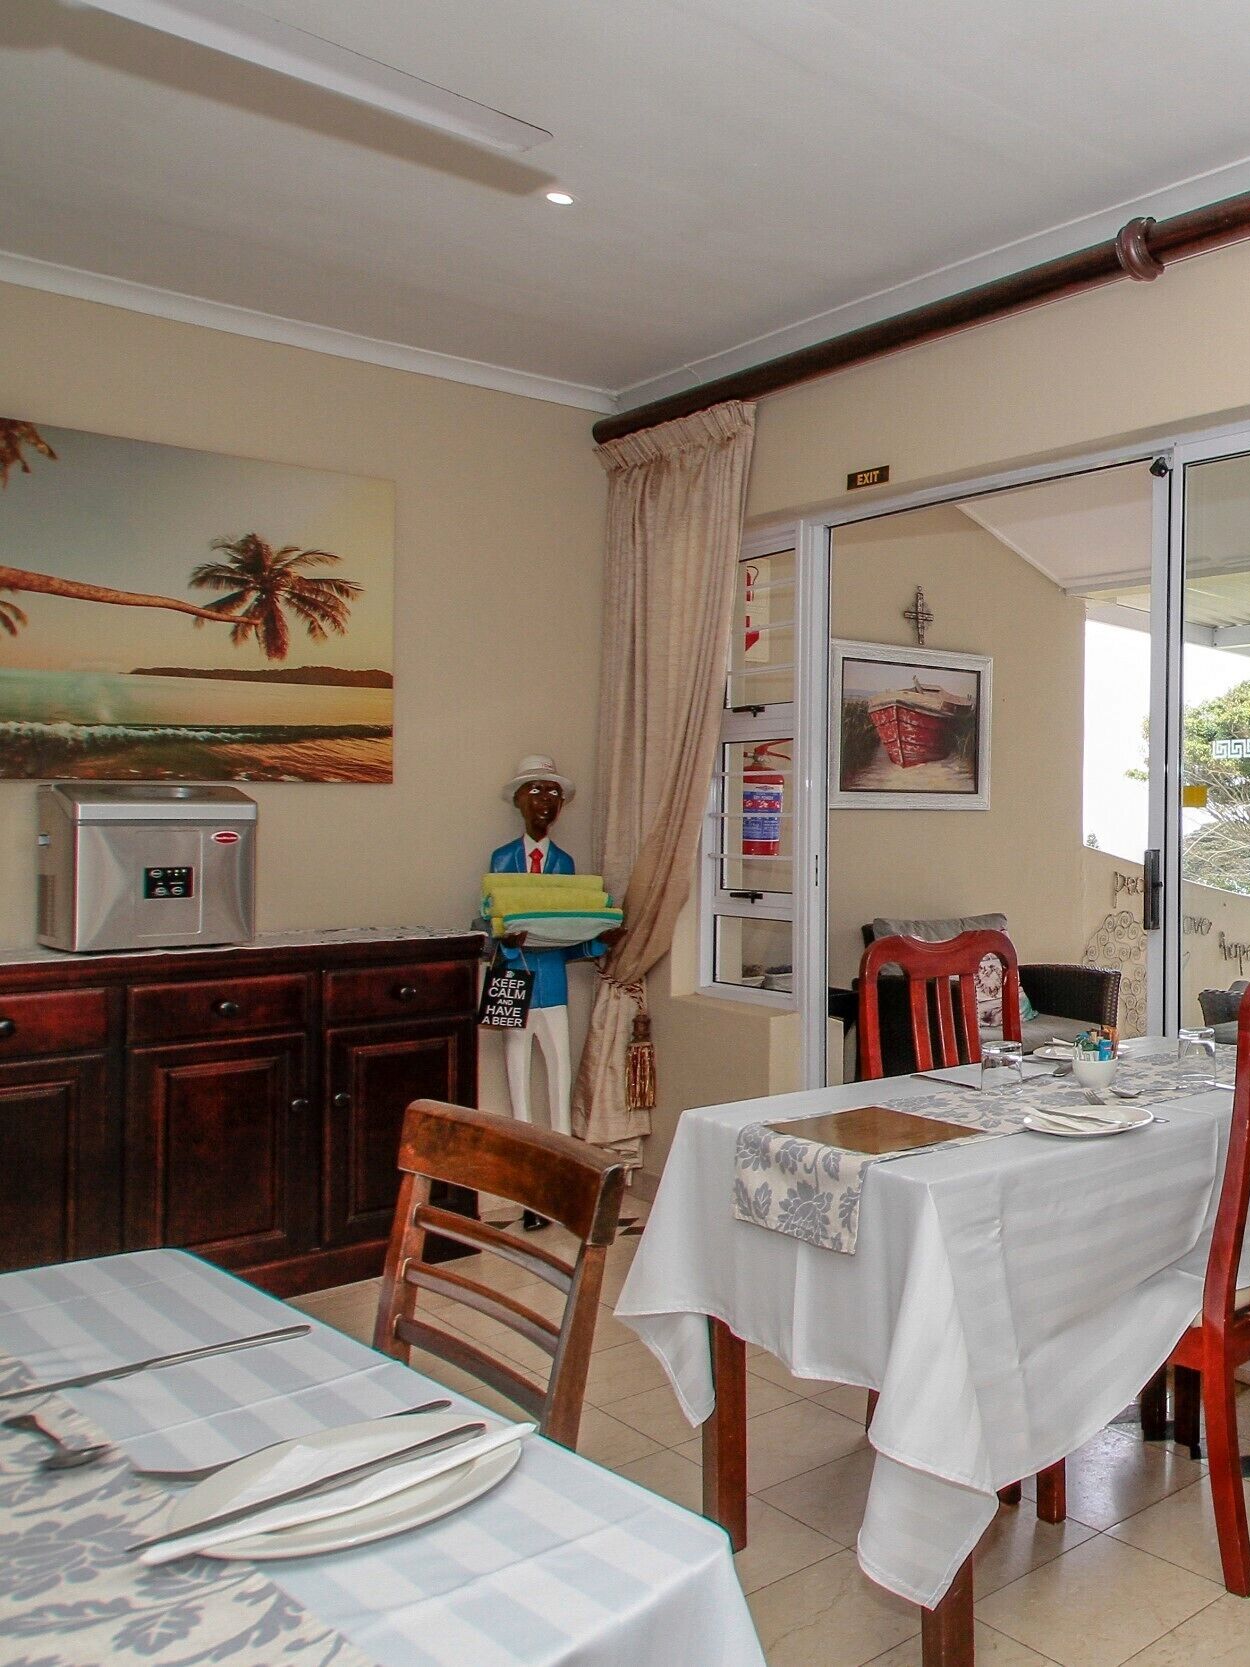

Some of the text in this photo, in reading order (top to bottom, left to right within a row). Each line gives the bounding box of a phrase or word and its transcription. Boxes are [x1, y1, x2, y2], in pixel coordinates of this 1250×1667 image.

[856, 470, 880, 486] EXIT
[1183, 916, 1213, 936] ove
[492, 977, 526, 989] KEEP
[488, 986, 526, 1000] CALM
[497, 998, 514, 1006] AND
[485, 1004, 522, 1017] HAVE
[481, 1015, 523, 1027] A BEER
